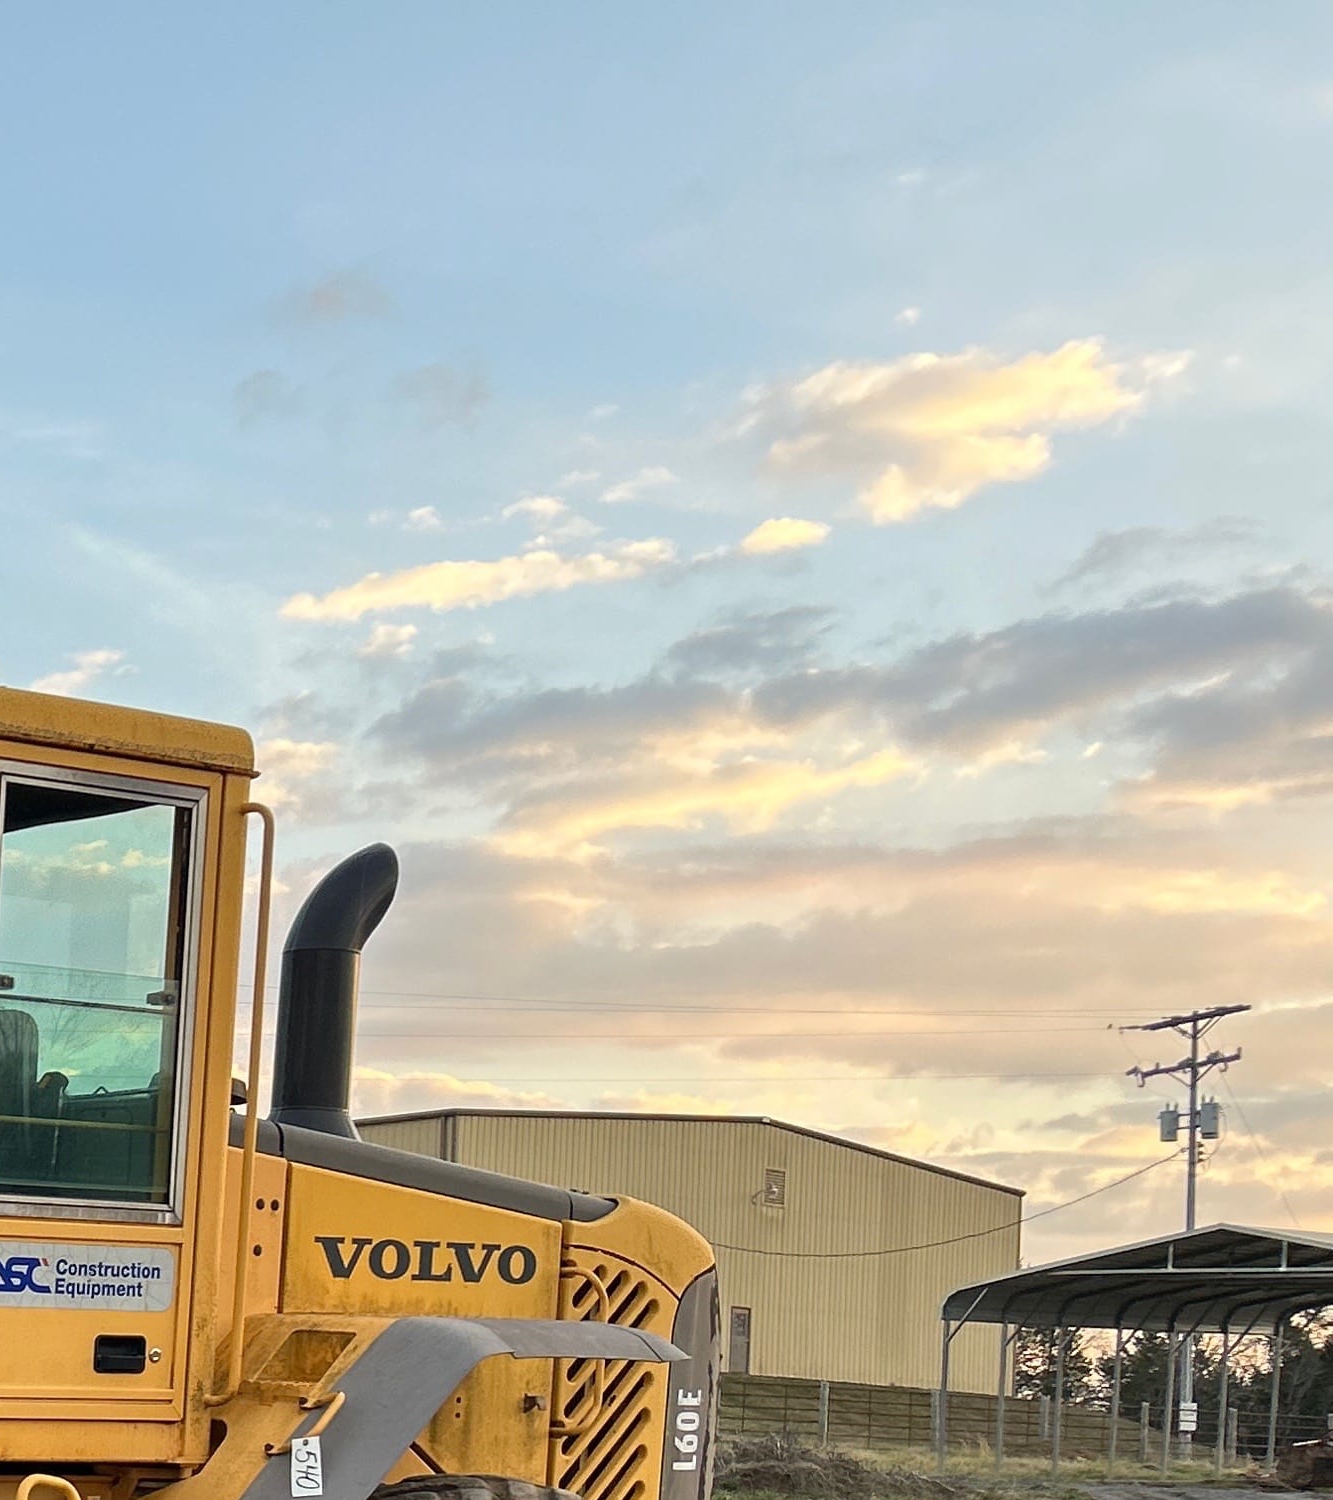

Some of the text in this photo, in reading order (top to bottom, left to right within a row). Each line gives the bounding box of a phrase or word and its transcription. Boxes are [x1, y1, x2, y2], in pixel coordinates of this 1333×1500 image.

[55, 1258, 161, 1280] Construction
[314, 1236, 537, 1285] VOLVO
[55, 1278, 143, 1299] Equipment
[672, 1388, 702, 1471] L60E
[295, 1448, 320, 1489] 540
